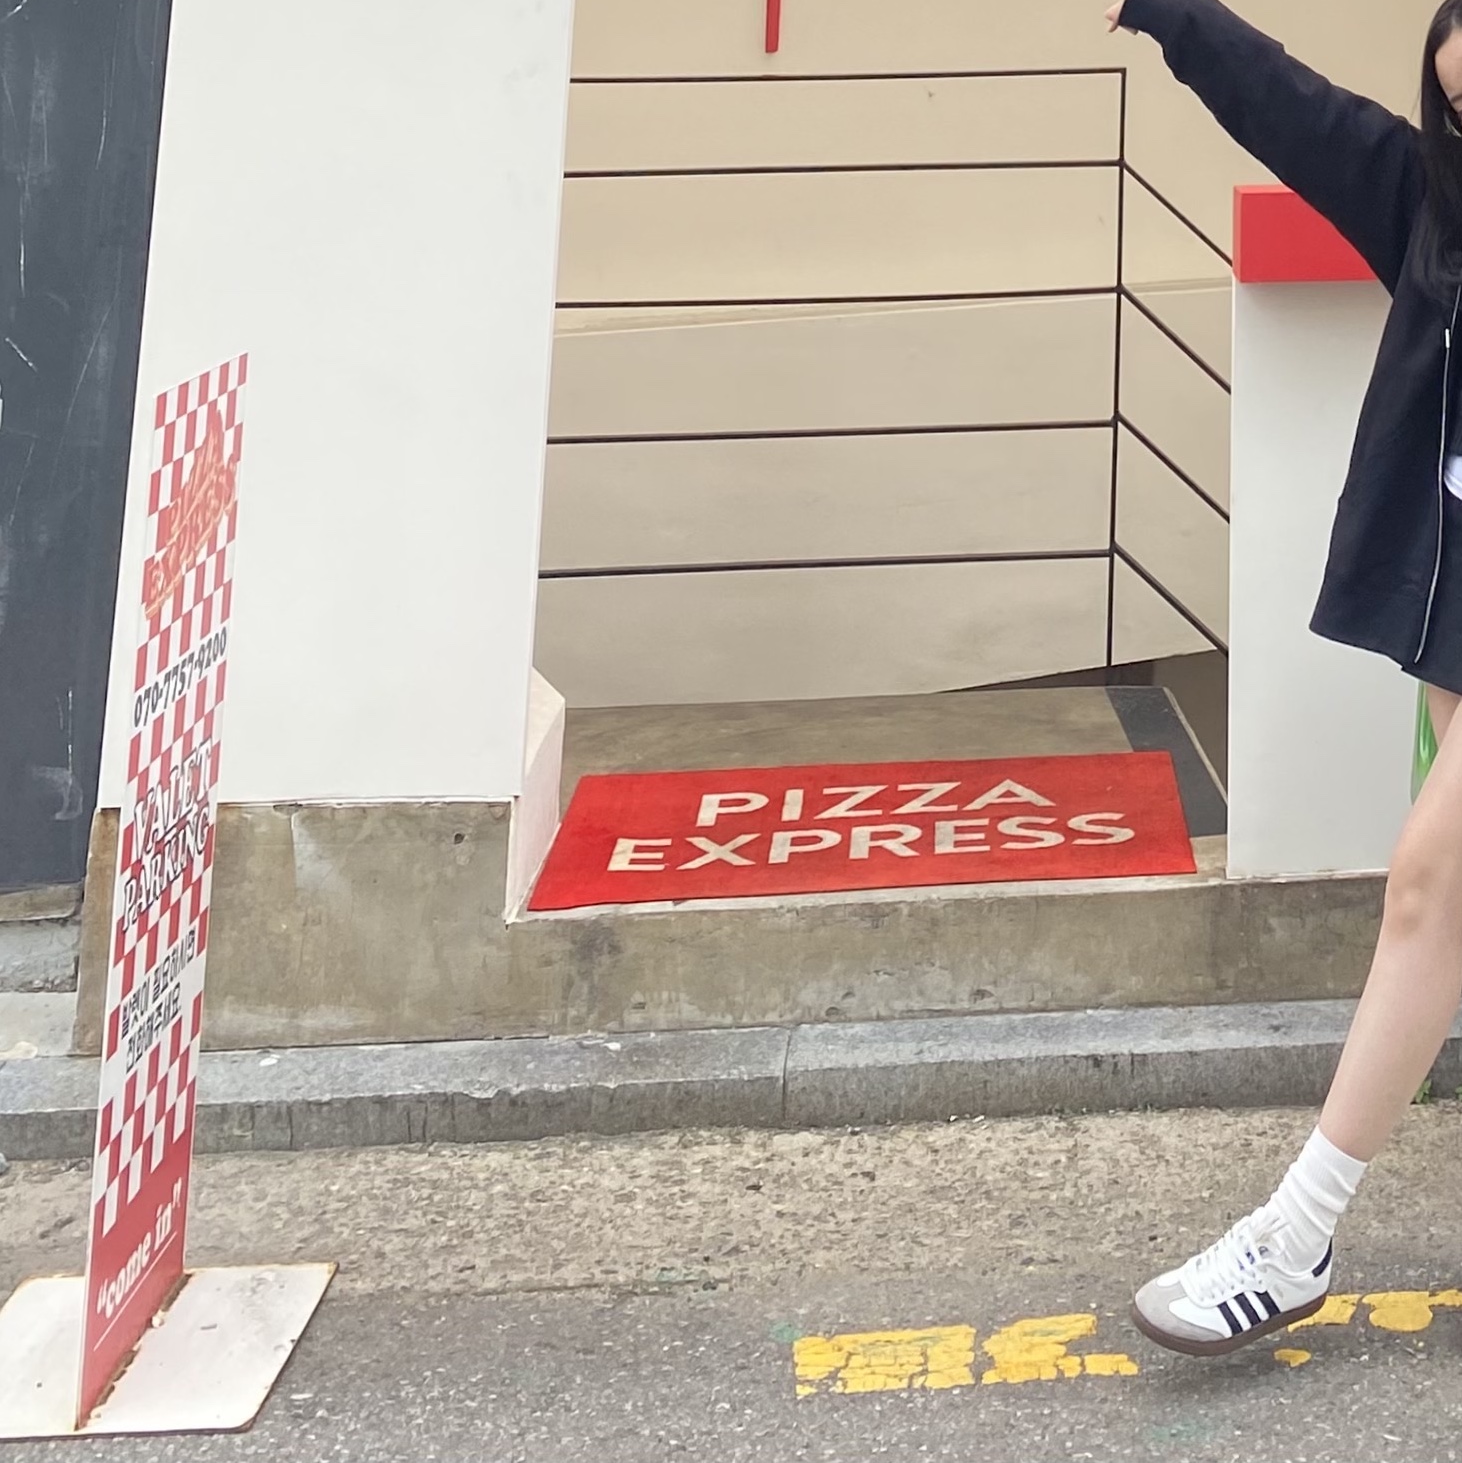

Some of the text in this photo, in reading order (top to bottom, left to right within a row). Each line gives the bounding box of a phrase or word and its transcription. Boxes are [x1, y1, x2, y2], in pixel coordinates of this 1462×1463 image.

[134, 626, 227, 728] 070-7757-9200
[134, 737, 213, 859] VALET
[607, 811, 1137, 873] EXPRESS
[695, 778, 1057, 828] PIZZA
[123, 803, 210, 934] PARKING
